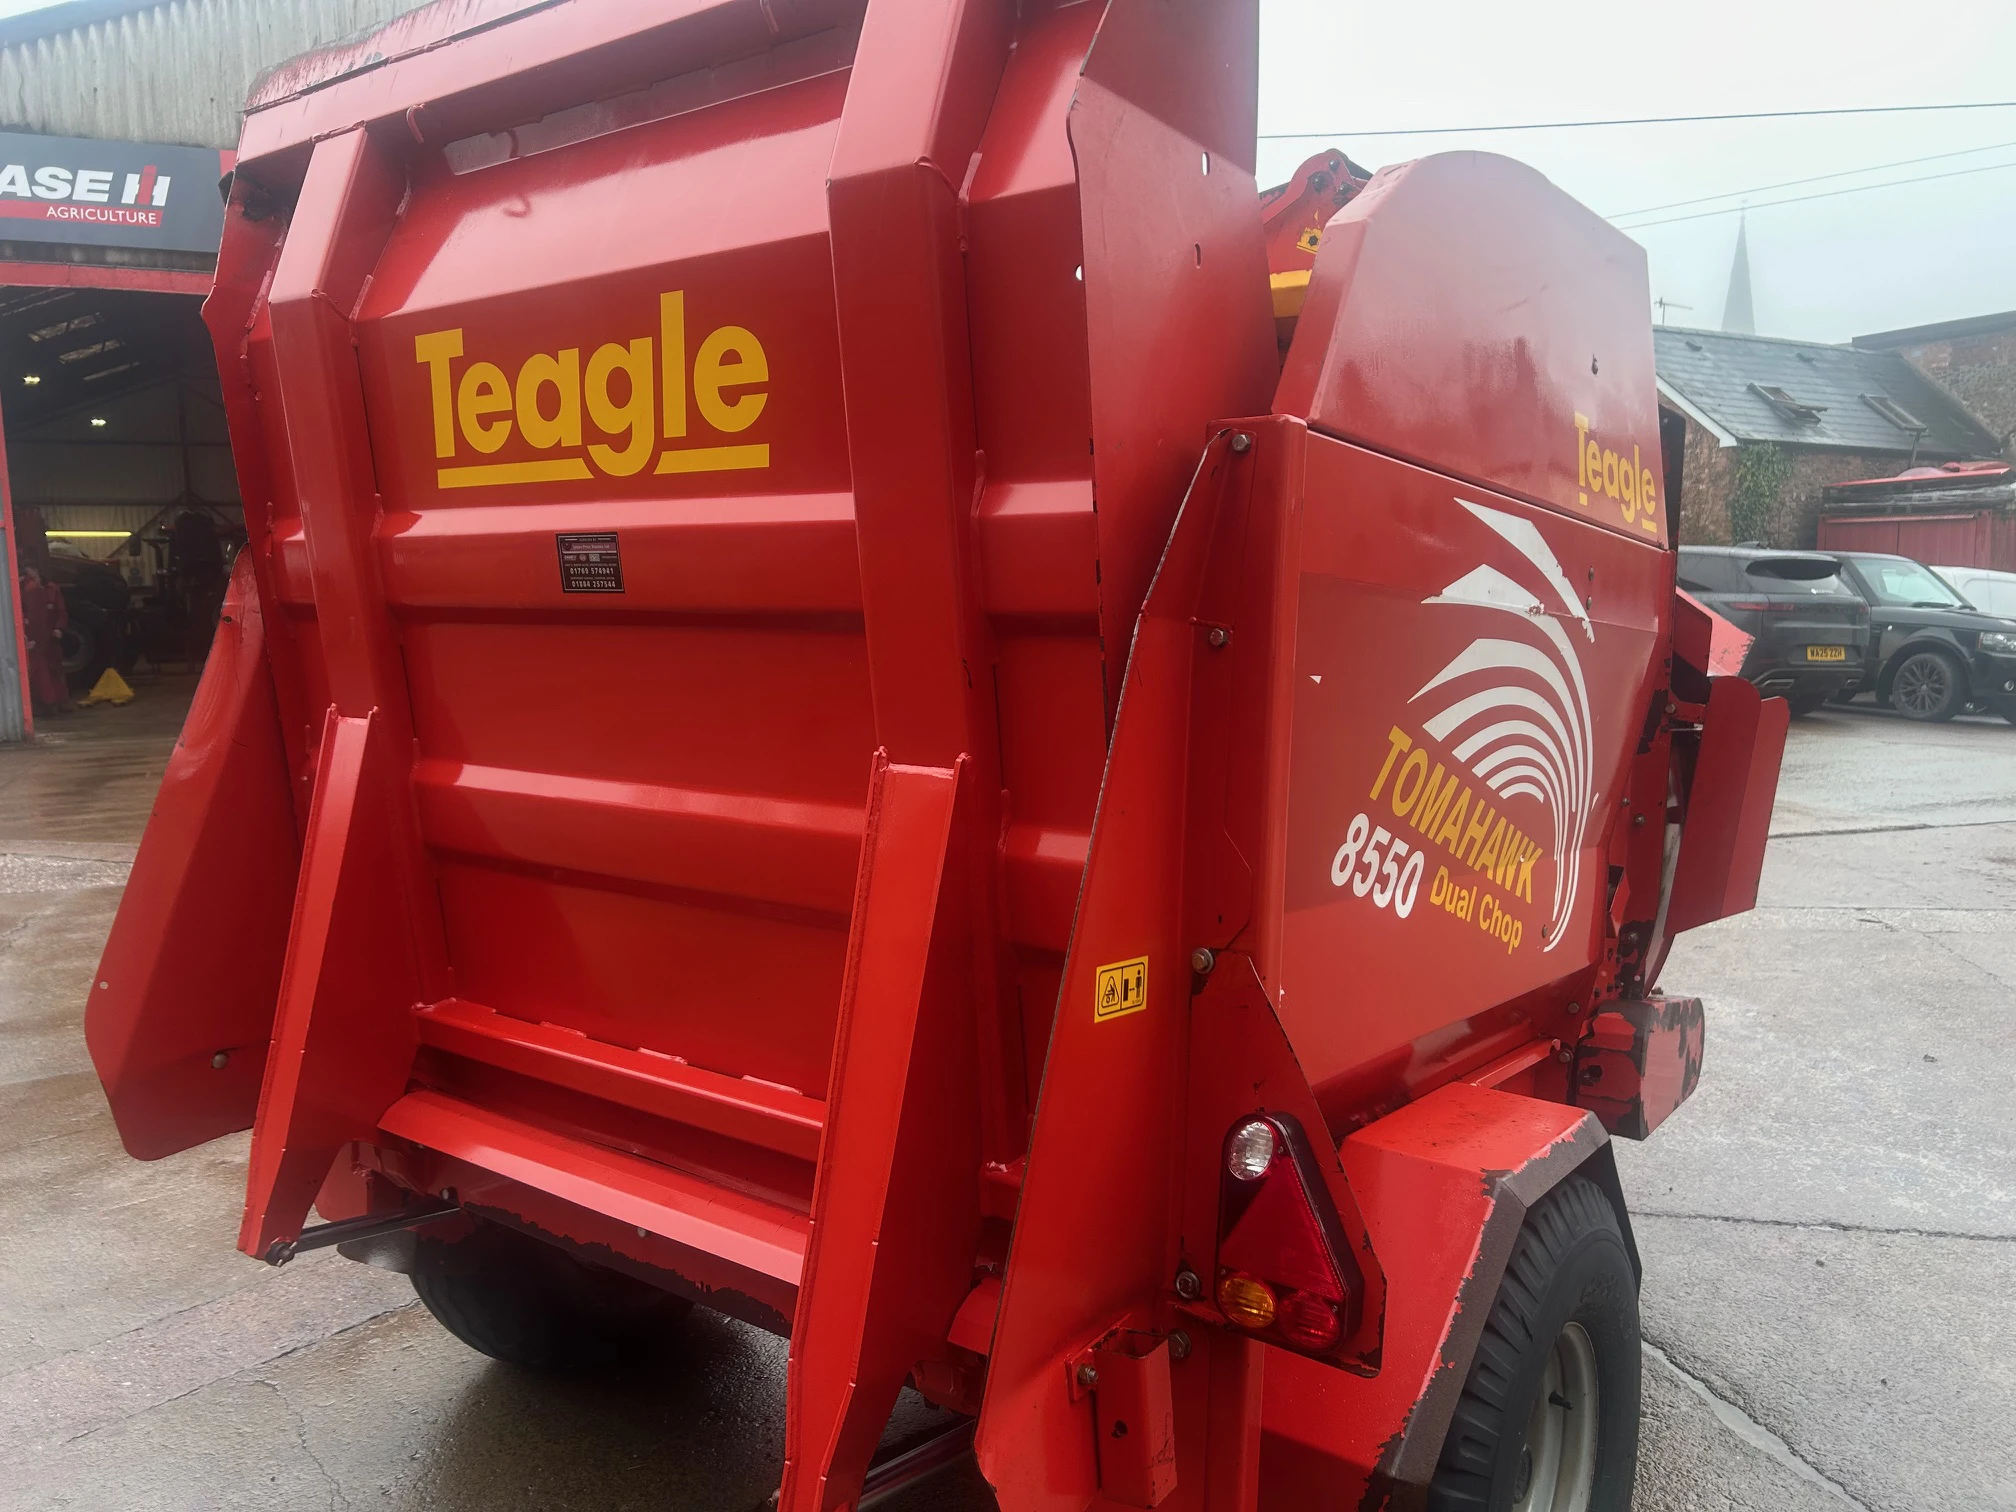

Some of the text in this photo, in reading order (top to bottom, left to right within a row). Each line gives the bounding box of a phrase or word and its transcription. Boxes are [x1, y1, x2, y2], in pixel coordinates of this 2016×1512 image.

[46, 206, 157, 225] AGRICULTURE
[415, 290, 769, 477] Teagle
[1574, 410, 1656, 523] Teagle
[1331, 813, 1425, 918] 8550
[1369, 725, 1544, 904] TOMAHAWK
[1429, 865, 1523, 955] Dual Chop
